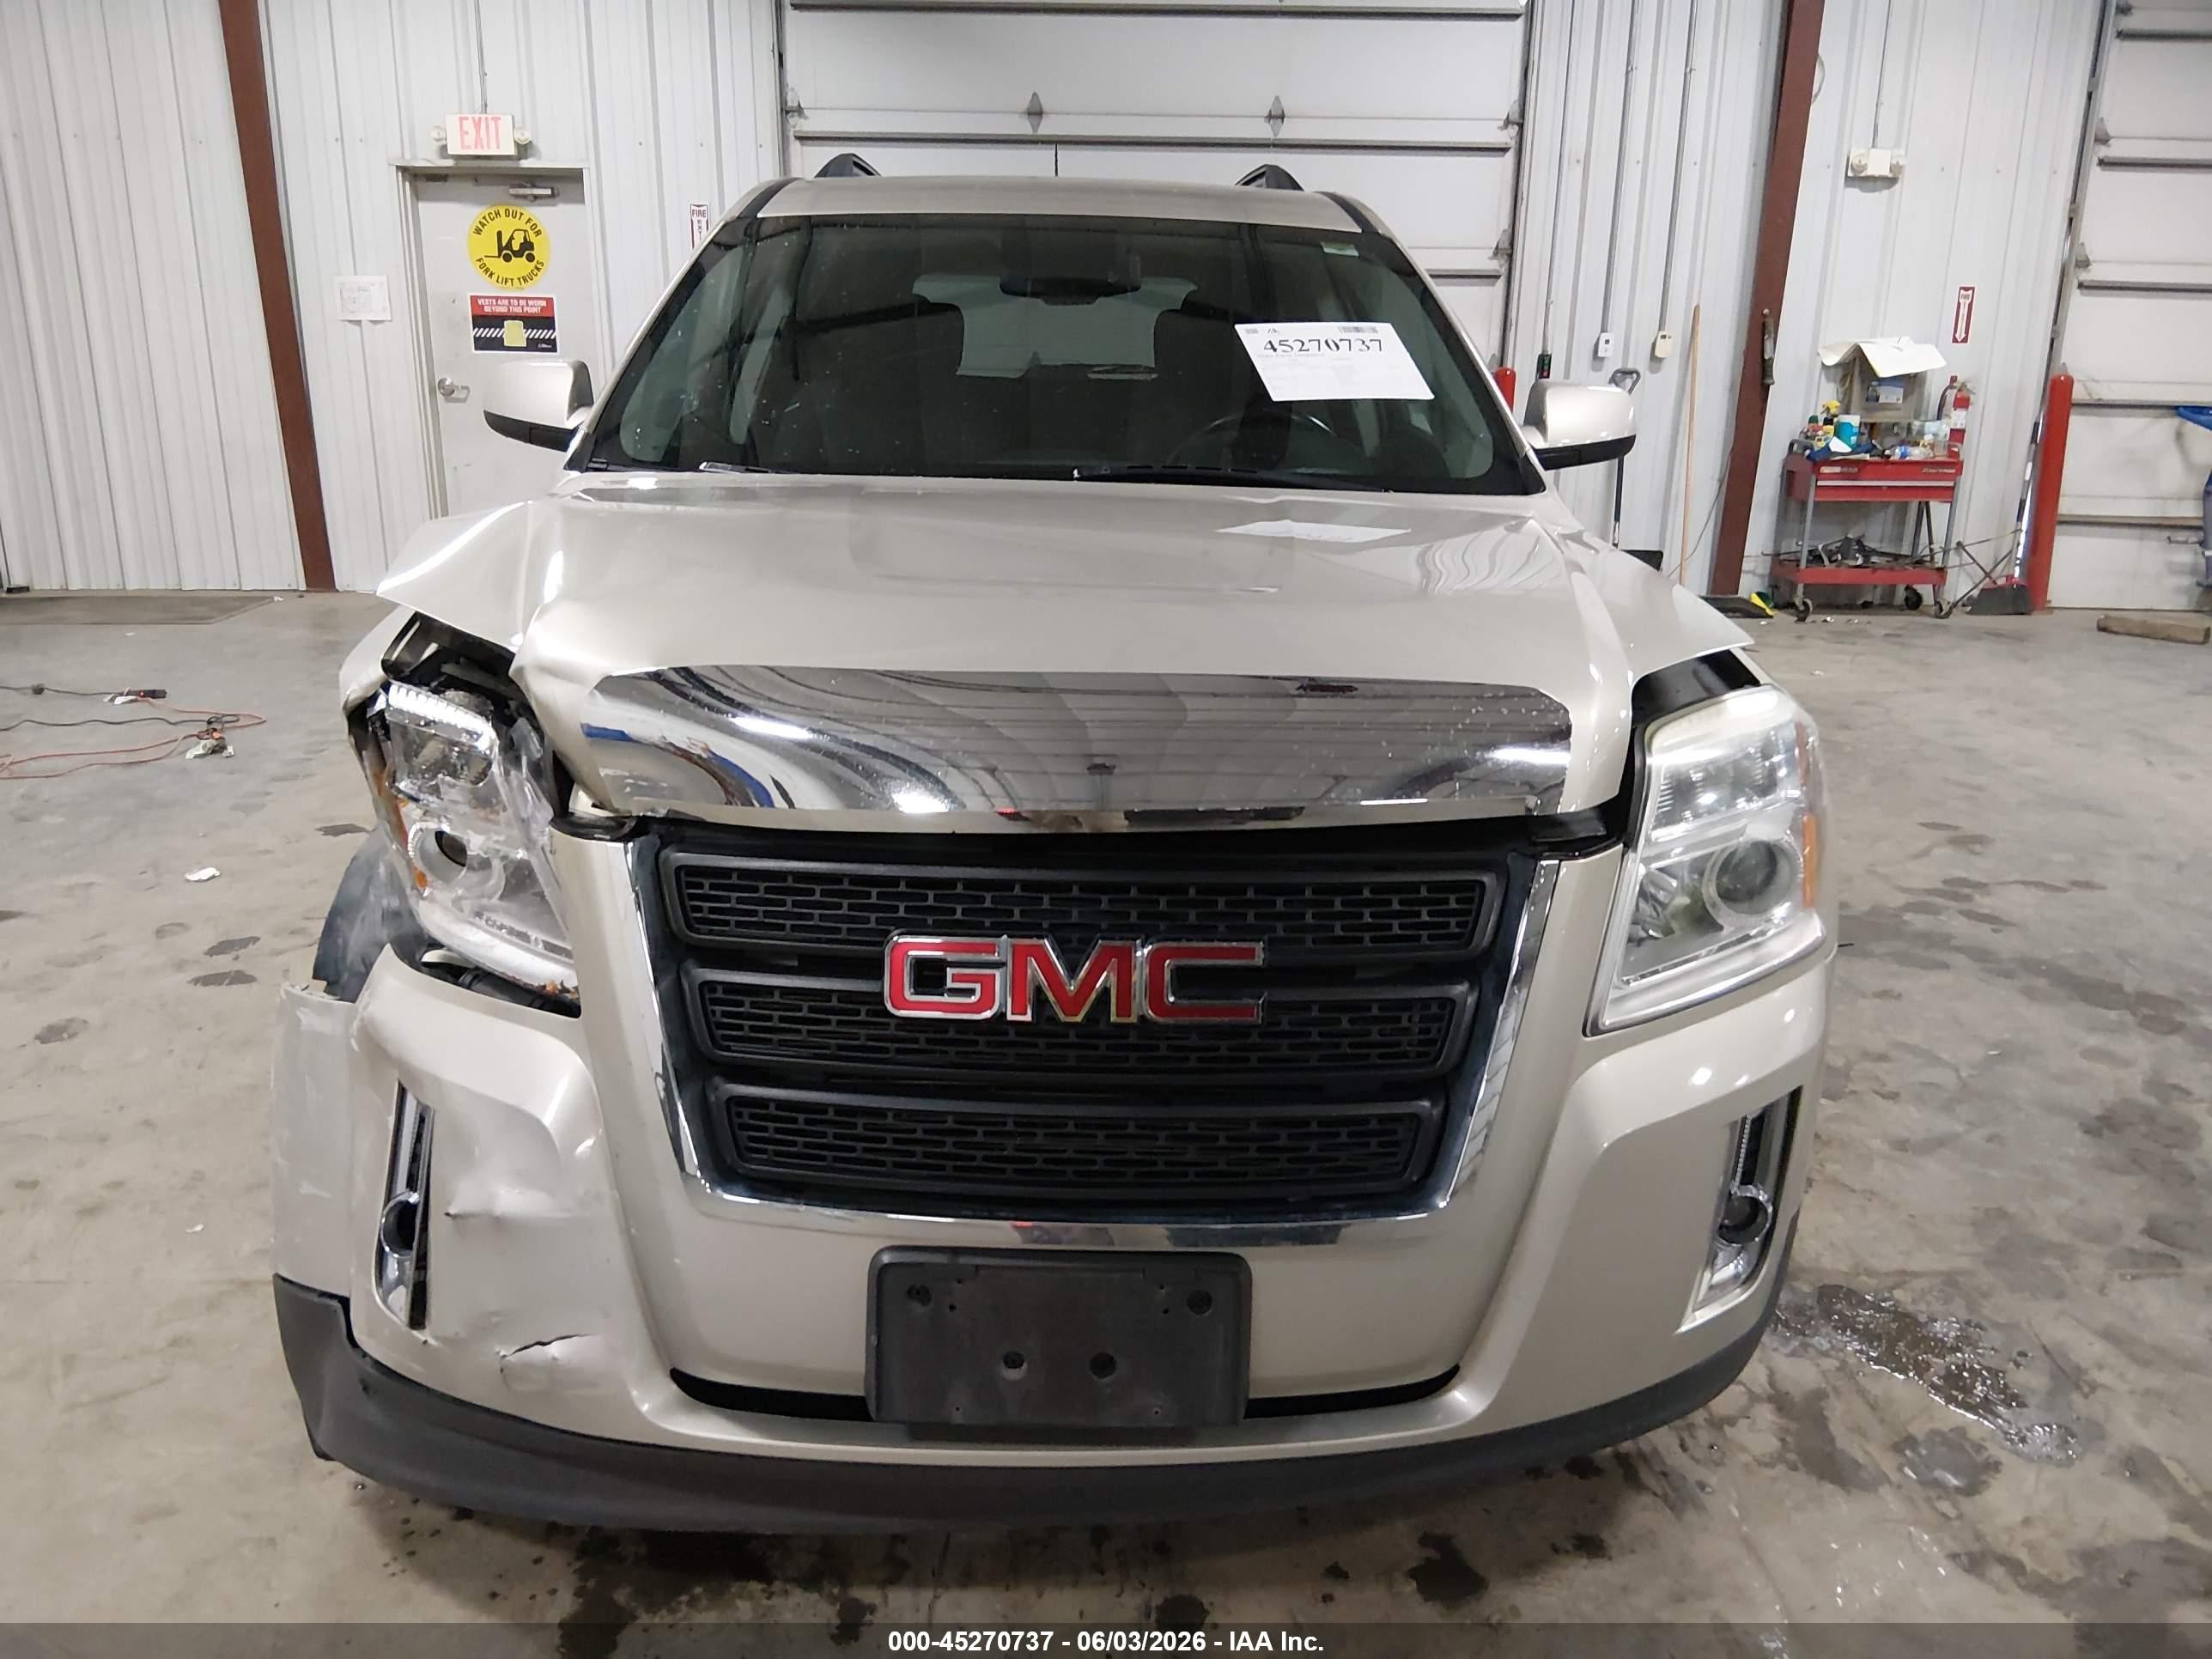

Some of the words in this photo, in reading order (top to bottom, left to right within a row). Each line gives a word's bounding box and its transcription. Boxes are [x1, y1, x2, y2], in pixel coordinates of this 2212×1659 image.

[458, 116, 501, 150] EXIT
[473, 209, 501, 236] WATCH
[504, 208, 525, 221] OUT
[525, 217, 542, 238] FOR
[691, 209, 707, 218] FIRE
[476, 257, 500, 280] FORK
[495, 274, 514, 287] LIFT
[517, 259, 544, 287] TRUCKS
[1263, 338, 1382, 353] 45270737
[884, 934, 1267, 1024] GMC
